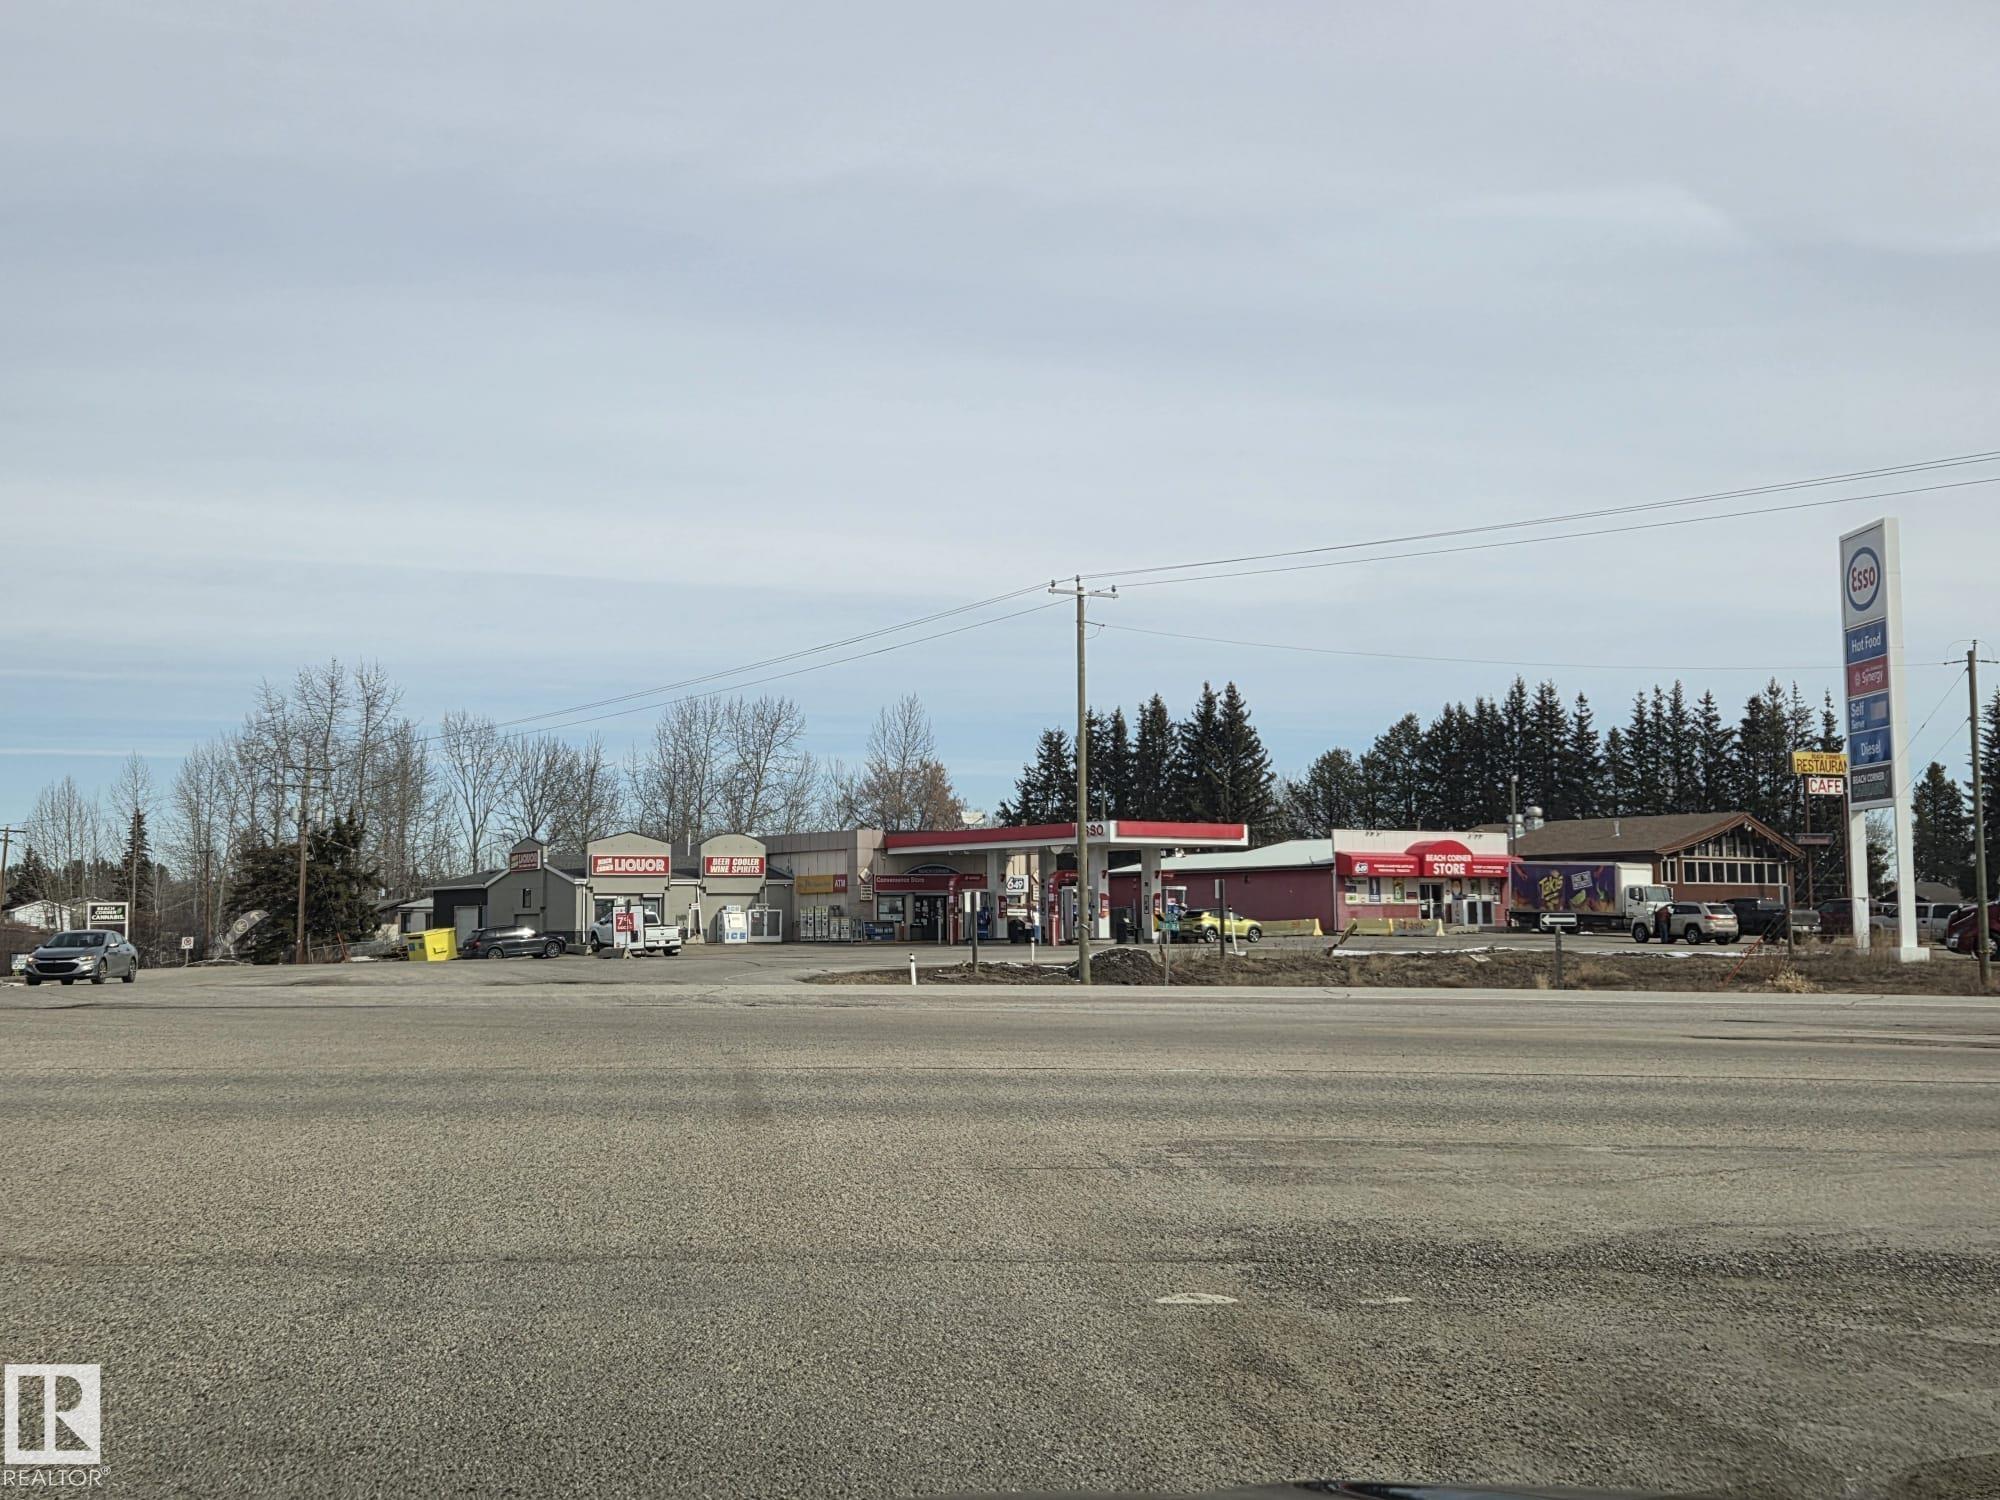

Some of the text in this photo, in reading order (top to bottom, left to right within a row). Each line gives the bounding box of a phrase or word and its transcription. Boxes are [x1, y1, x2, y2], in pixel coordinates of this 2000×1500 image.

[1851, 566, 1876, 592] Esso
[1851, 632, 1881, 653] Hot Food
[1862, 670, 1884, 686] Synergy
[1851, 701, 1865, 717] Self
[1860, 739, 1881, 756] Diesel
[1796, 758, 1847, 773] RESTAURAN
[1810, 779, 1842, 793] CAFE
[614, 858, 665, 872] LIQUOR
[712, 858, 760, 866] BEER COOLER
[1425, 854, 1472, 862] BEACH CORNER
[1433, 863, 1466, 875] STORE
[834, 879, 846, 888] ATM
[726, 932, 746, 940] ICE
